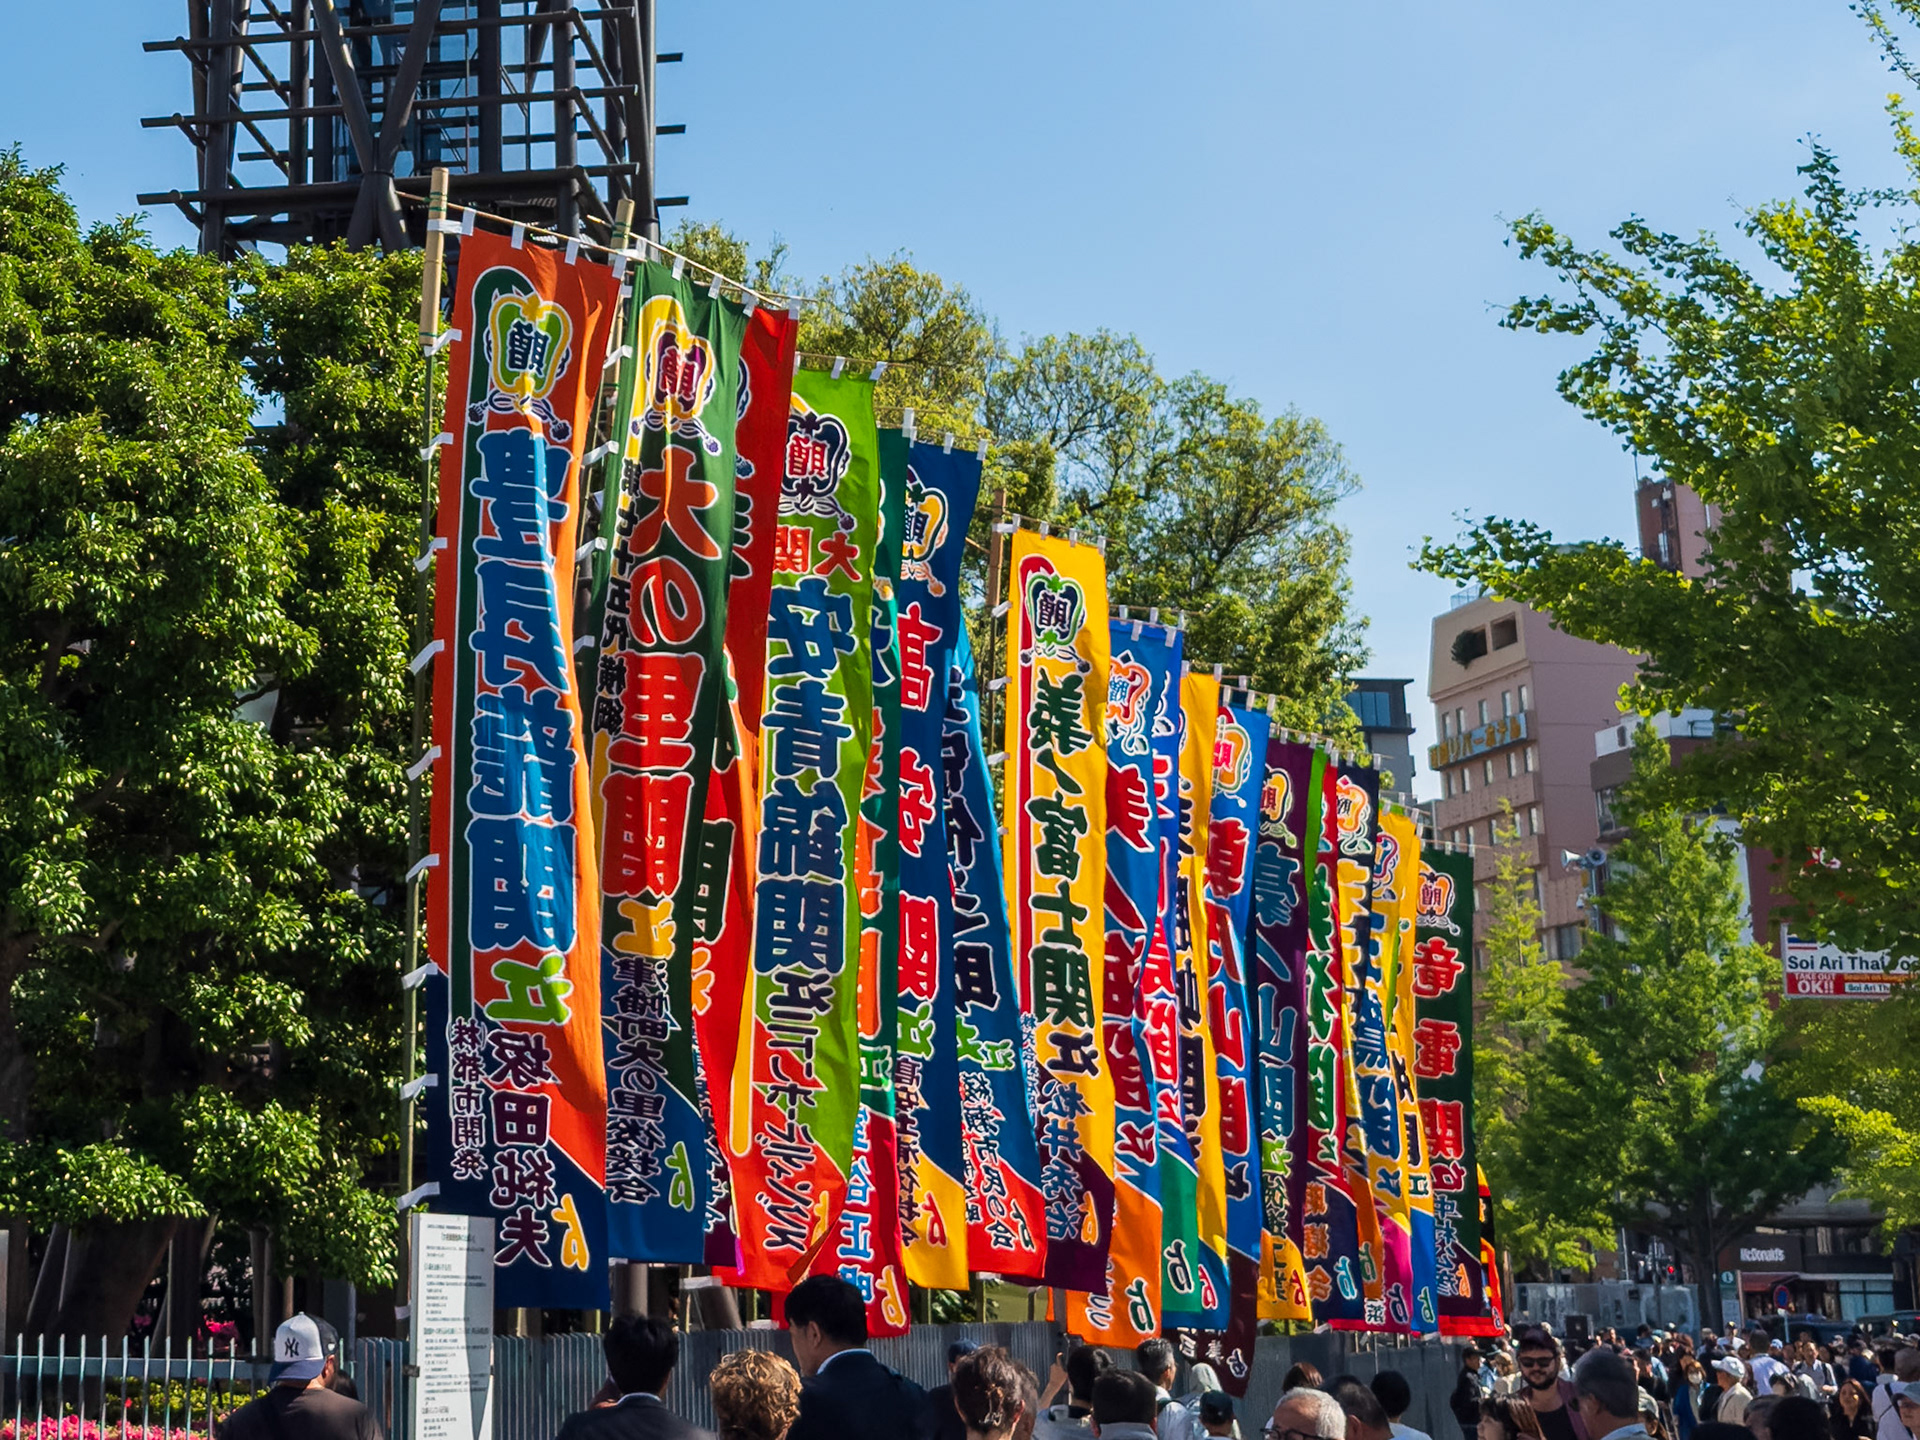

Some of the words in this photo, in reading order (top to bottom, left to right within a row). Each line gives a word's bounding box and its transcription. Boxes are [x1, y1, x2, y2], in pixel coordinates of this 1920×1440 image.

[1788, 955, 1814, 970] Soi
[1819, 955, 1843, 970] Ari
[1847, 953, 1885, 970] Thai
[1797, 981, 1834, 993] OK!!
[1740, 1247, 1785, 1261] McDonald's
